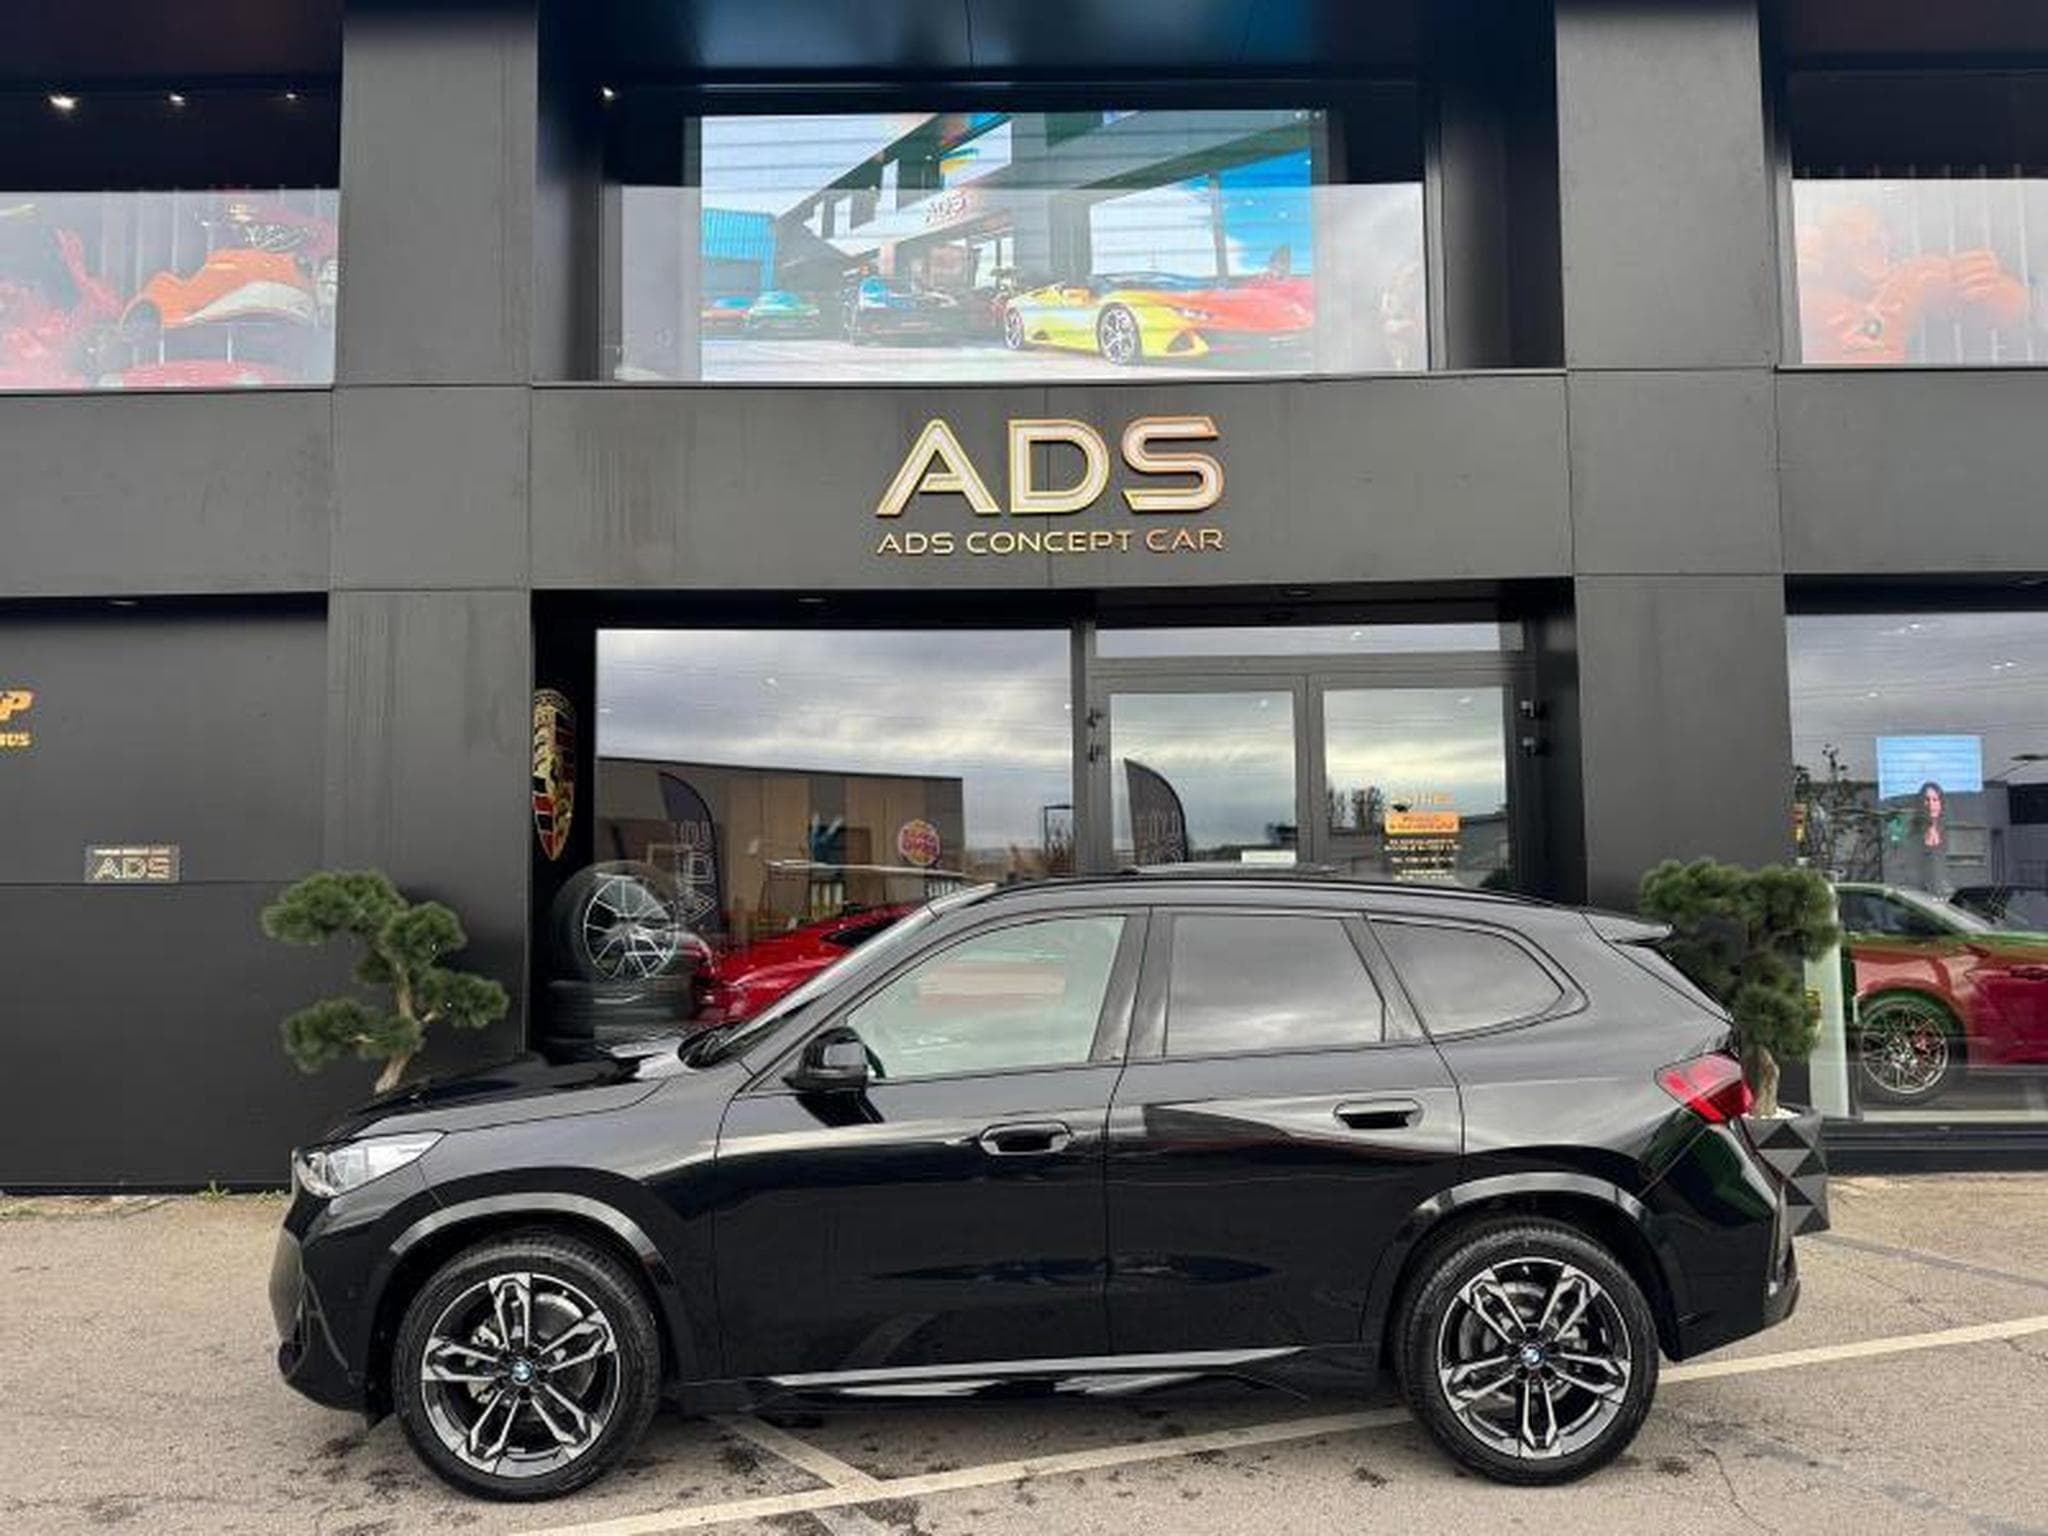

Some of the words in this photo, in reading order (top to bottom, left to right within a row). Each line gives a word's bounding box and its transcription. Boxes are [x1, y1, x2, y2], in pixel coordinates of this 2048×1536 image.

[876, 416, 1224, 515] ADS
[877, 532, 954, 555] ADS
[966, 530, 1131, 554] CONCEPT
[1145, 529, 1223, 552] CAR
[94, 857, 170, 880] ADS
